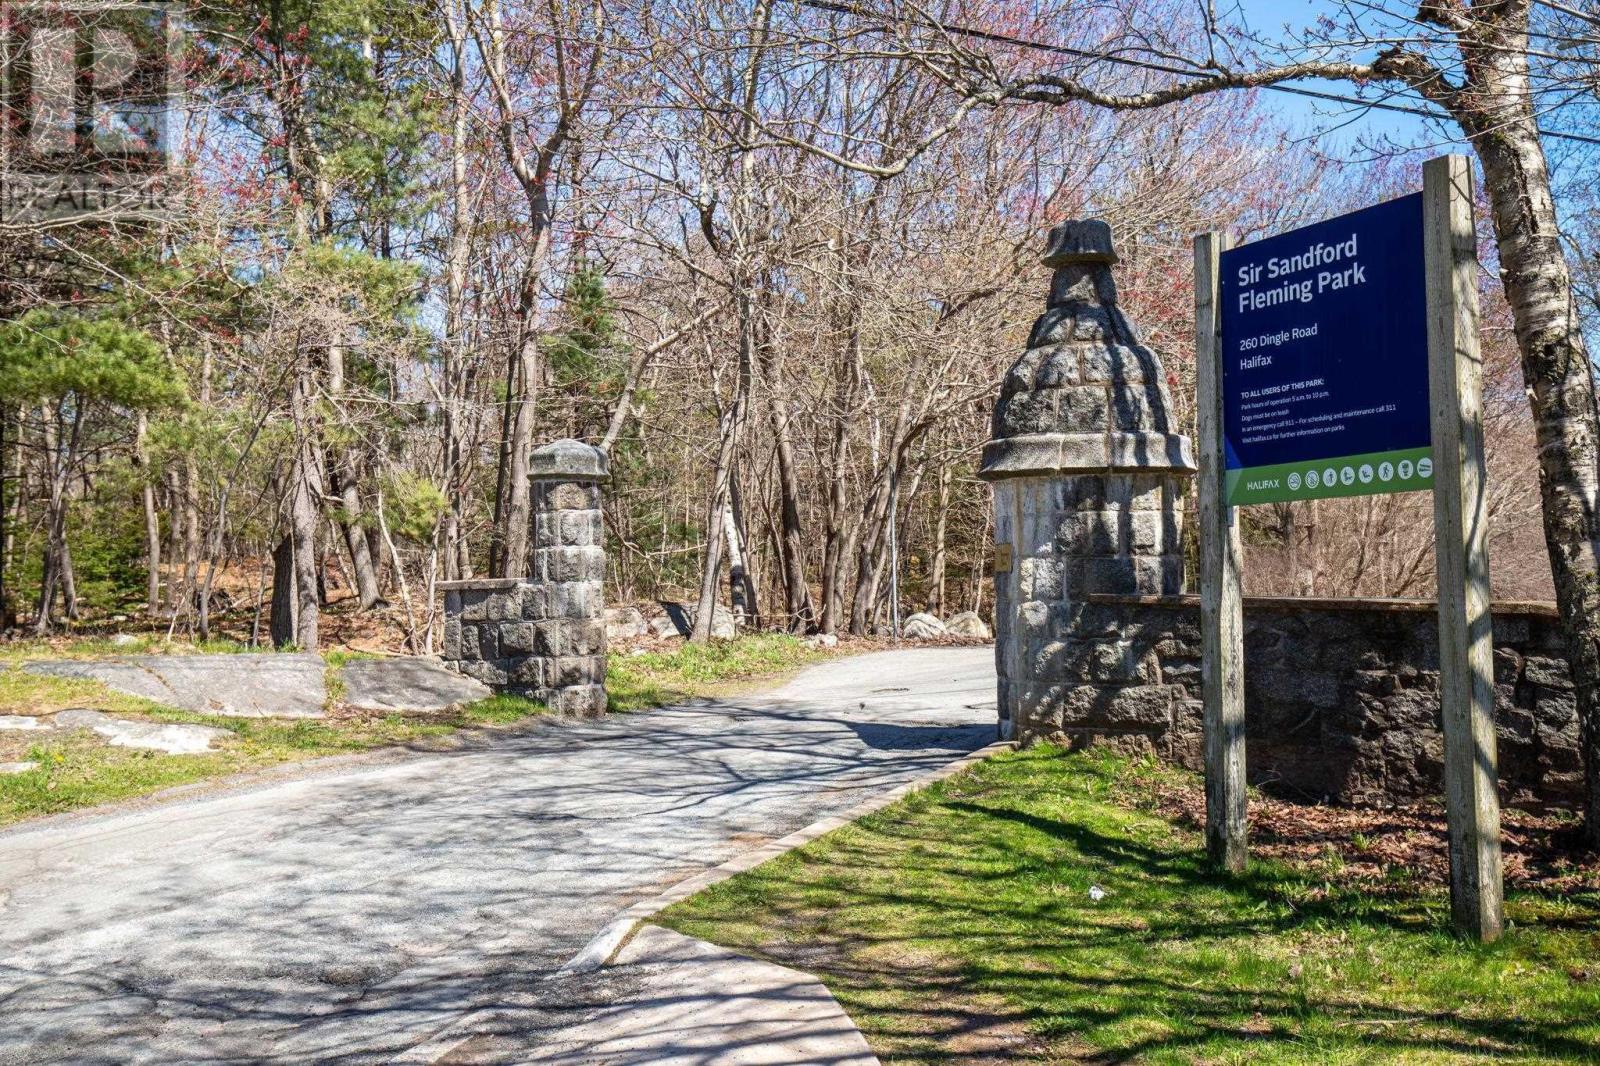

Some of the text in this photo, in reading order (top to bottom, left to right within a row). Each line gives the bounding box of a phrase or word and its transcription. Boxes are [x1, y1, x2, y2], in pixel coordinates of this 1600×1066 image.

[1238, 233, 1357, 287] Sir Sandford
[1239, 262, 1366, 313] Fleming Park
[1239, 322, 1318, 351] 260 Dingle Road
[1240, 355, 1272, 370] Halifax
[1240, 391, 1250, 399] TO
[1261, 386, 1281, 396] USERS
[1281, 384, 1290, 392] OF
[1291, 381, 1305, 390] THIS
[1270, 396, 1292, 406] operation
[1247, 479, 1280, 491] HALIFAX
